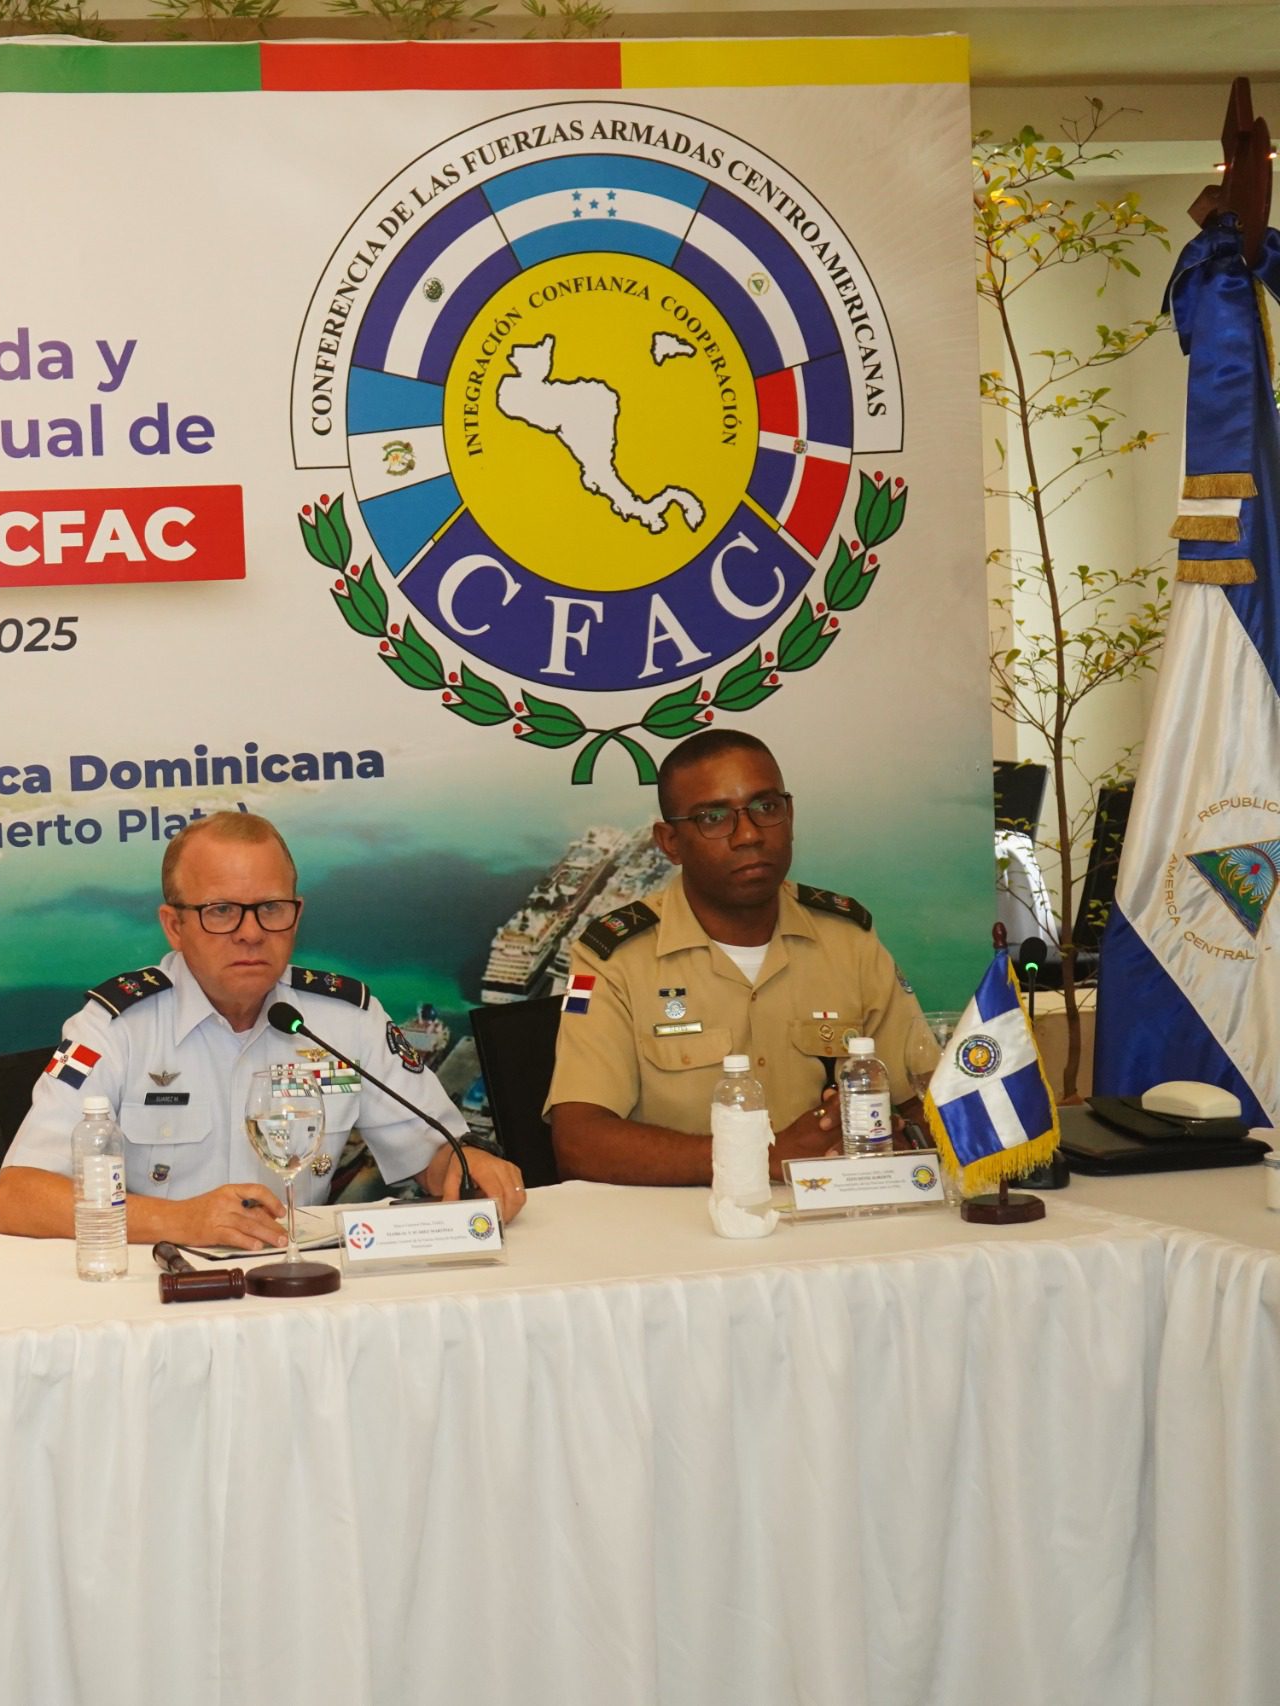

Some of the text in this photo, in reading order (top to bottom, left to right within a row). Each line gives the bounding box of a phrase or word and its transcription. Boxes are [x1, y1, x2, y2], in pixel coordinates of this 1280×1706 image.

[311, 119, 887, 435] CONFERENCIA DE LAS FUERZAS ARMADAS CENTROAMERICANAS
[95, 339, 138, 393] y
[464, 276, 742, 457] INTEGRACIÓN CONFIANZA COOPERACIÓN
[128, 402, 216, 456] de
[436, 532, 787, 679] CFAC
[70, 742, 385, 793] Dominicana
[118, 802, 249, 843] Pla
[1183, 930, 1255, 960] CENTRAL
